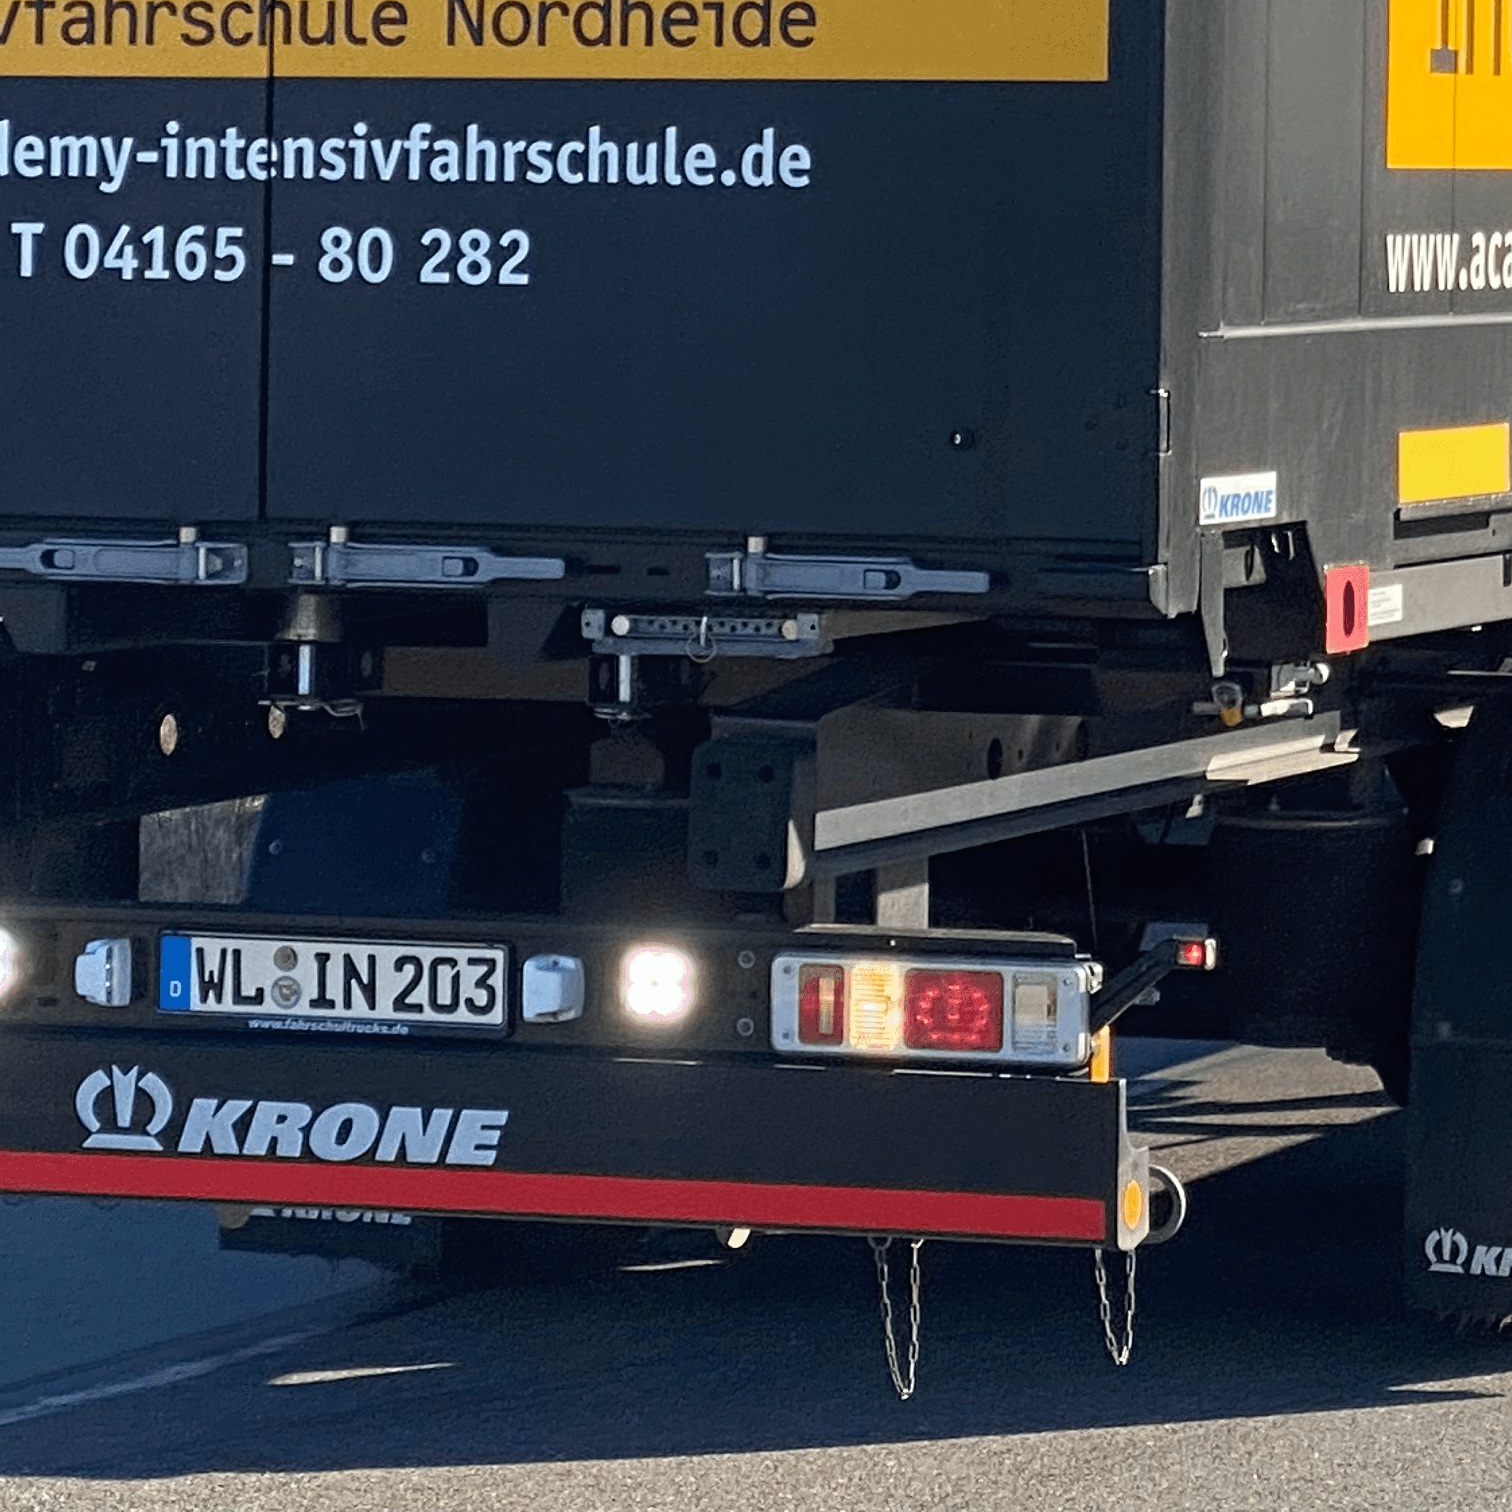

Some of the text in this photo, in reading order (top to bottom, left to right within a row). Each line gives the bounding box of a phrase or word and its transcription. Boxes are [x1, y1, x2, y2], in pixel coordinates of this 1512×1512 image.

[11, 222, 531, 285] T 04165 - 80 282
[1218, 489, 1274, 518] KRONE
[195, 946, 498, 1016] WL IN 203
[177, 1097, 509, 1166] KRONE
